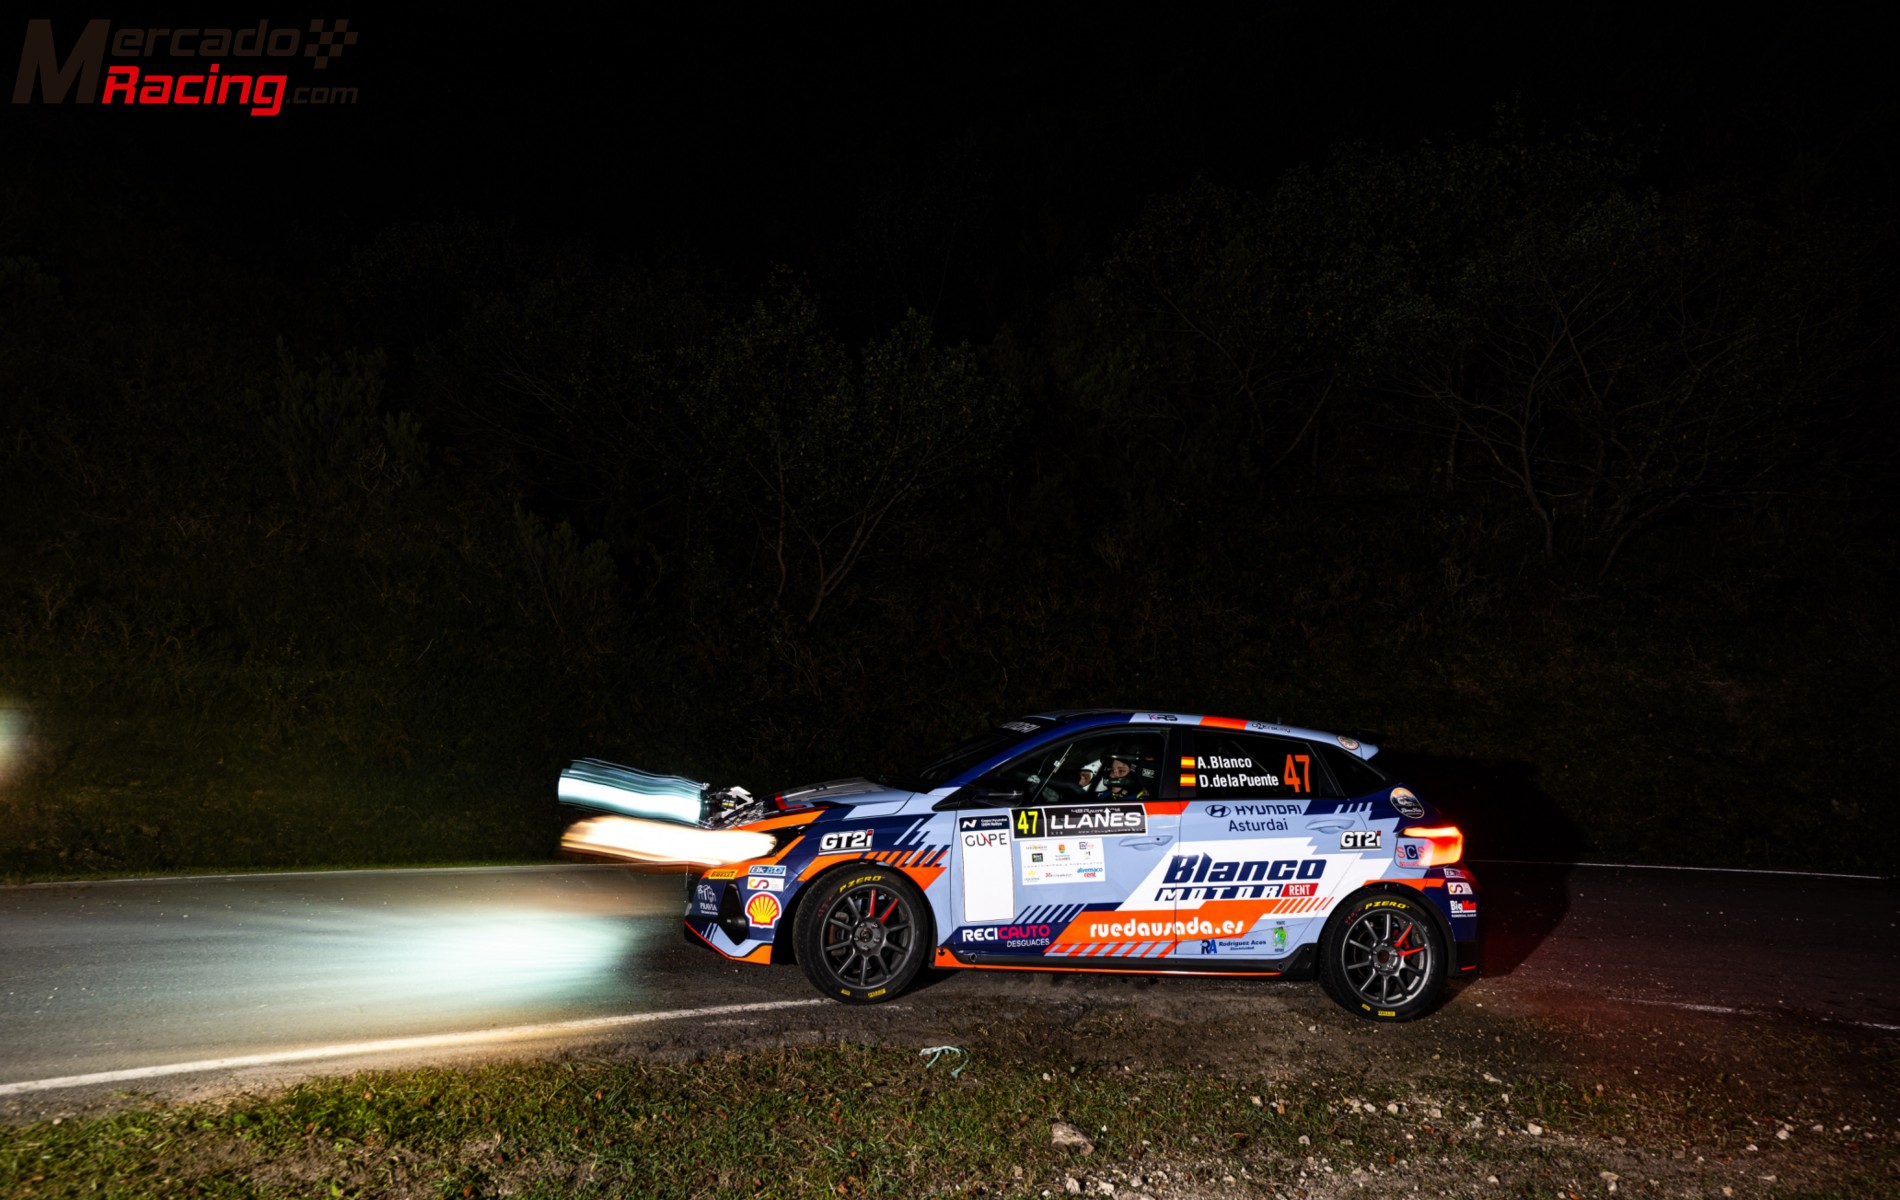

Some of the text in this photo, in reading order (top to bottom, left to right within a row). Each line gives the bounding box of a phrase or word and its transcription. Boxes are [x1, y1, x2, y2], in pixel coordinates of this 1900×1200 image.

[1197, 755, 1252, 769] A.Blanco
[1283, 754, 1310, 793] 47
[1234, 804, 1302, 816] HYUNDAI
[1017, 810, 1039, 835] 47
[1050, 811, 1142, 830] LLANES
[1228, 818, 1288, 832] Asturdai
[820, 829, 874, 850] GT2i
[1340, 830, 1382, 848] GT2i
[1162, 851, 1327, 884] Blanco
[1154, 884, 1311, 902] MOTOR RENT
[962, 924, 1051, 943] RECICAUTO
[1090, 917, 1244, 938] ruedausada.es
[1006, 938, 1050, 948] DESGUACES
